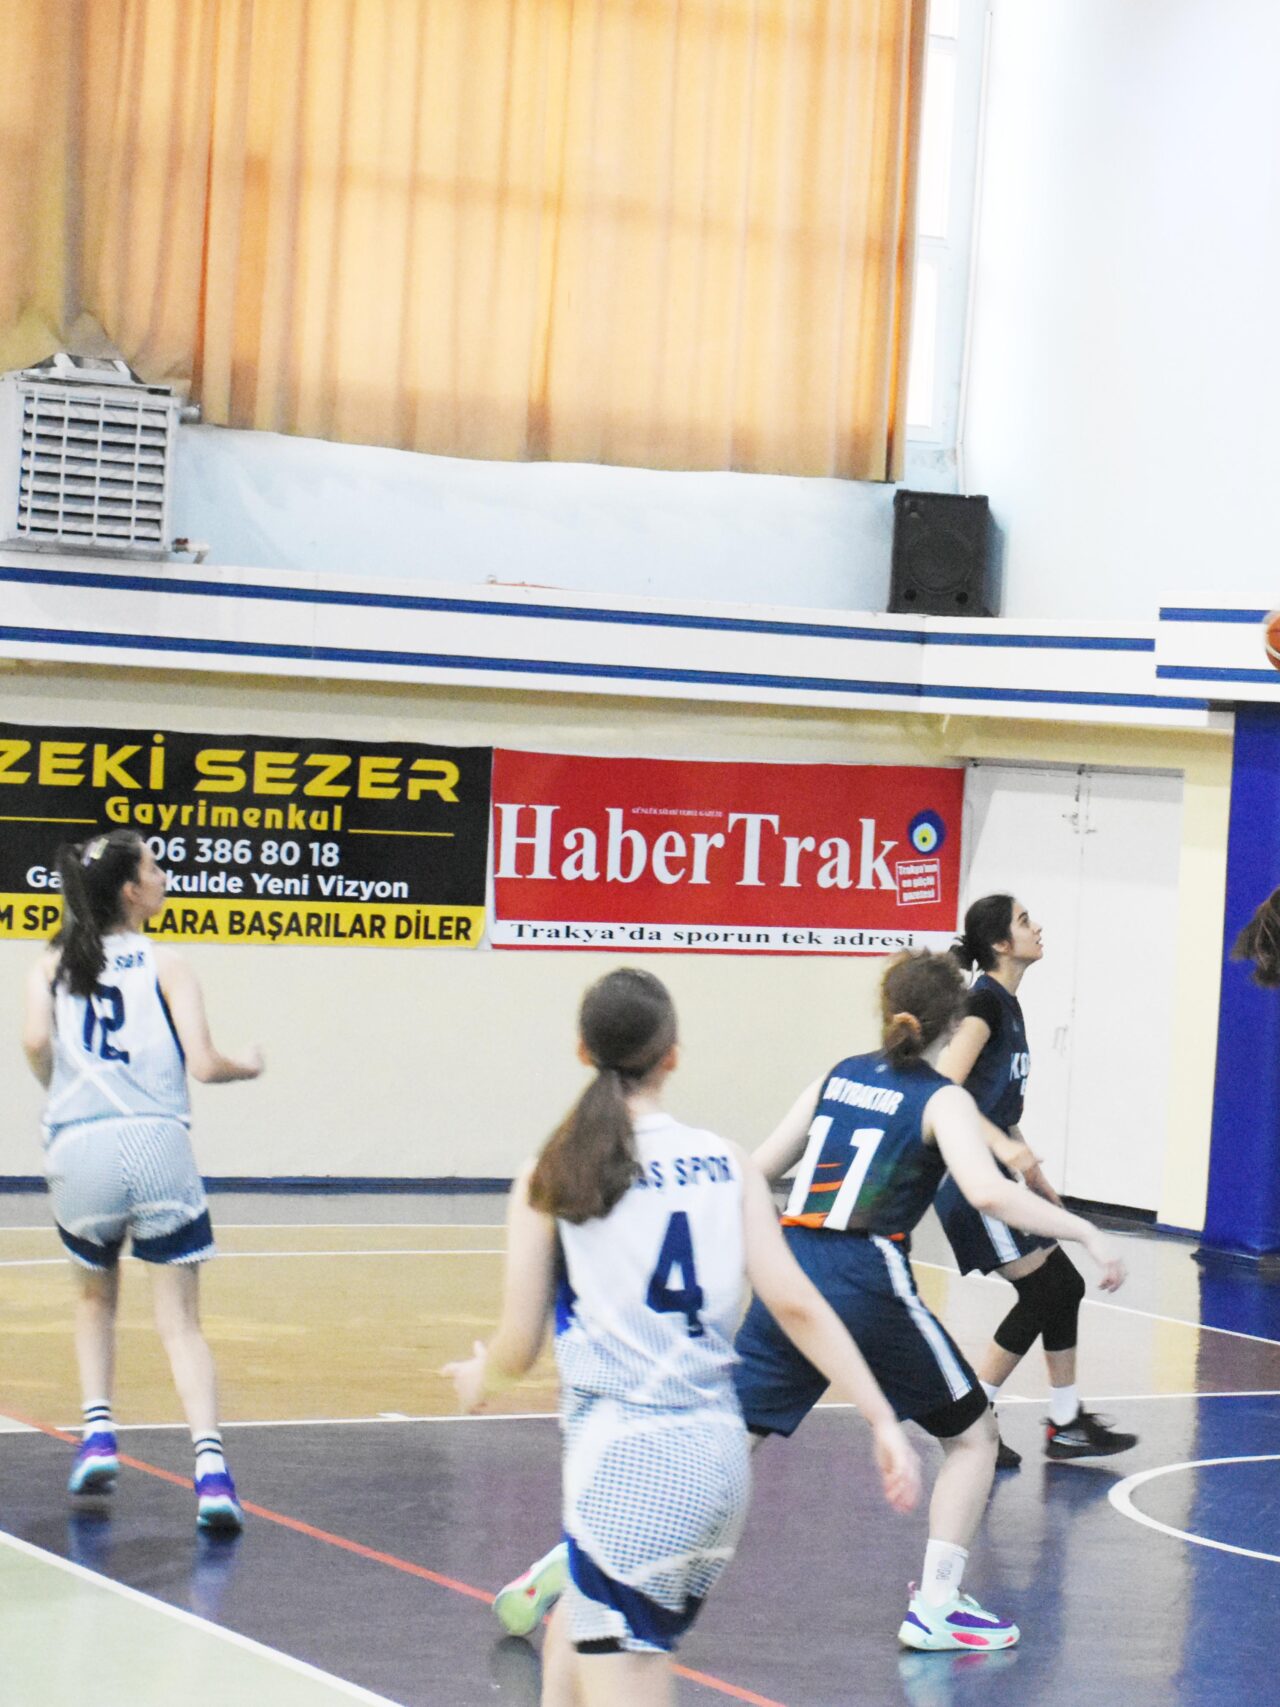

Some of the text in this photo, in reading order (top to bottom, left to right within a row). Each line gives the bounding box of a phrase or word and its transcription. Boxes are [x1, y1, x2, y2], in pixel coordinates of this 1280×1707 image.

[0, 734, 460, 802] ZEKİ SEZER
[105, 796, 342, 832] Gayrimenkul
[144, 836, 339, 867] 06 386 80 18
[26, 865, 409, 901] Gakulde Yeni Vizyon
[23, 906, 219, 934] SPLARA
[230, 910, 386, 941] BAŞARILAR
[394, 910, 472, 941] DİLER
[511, 923, 914, 947] Trakya'da sporun tek adresi
[782, 1115, 886, 1231] 11
[646, 1210, 704, 1338] 4
